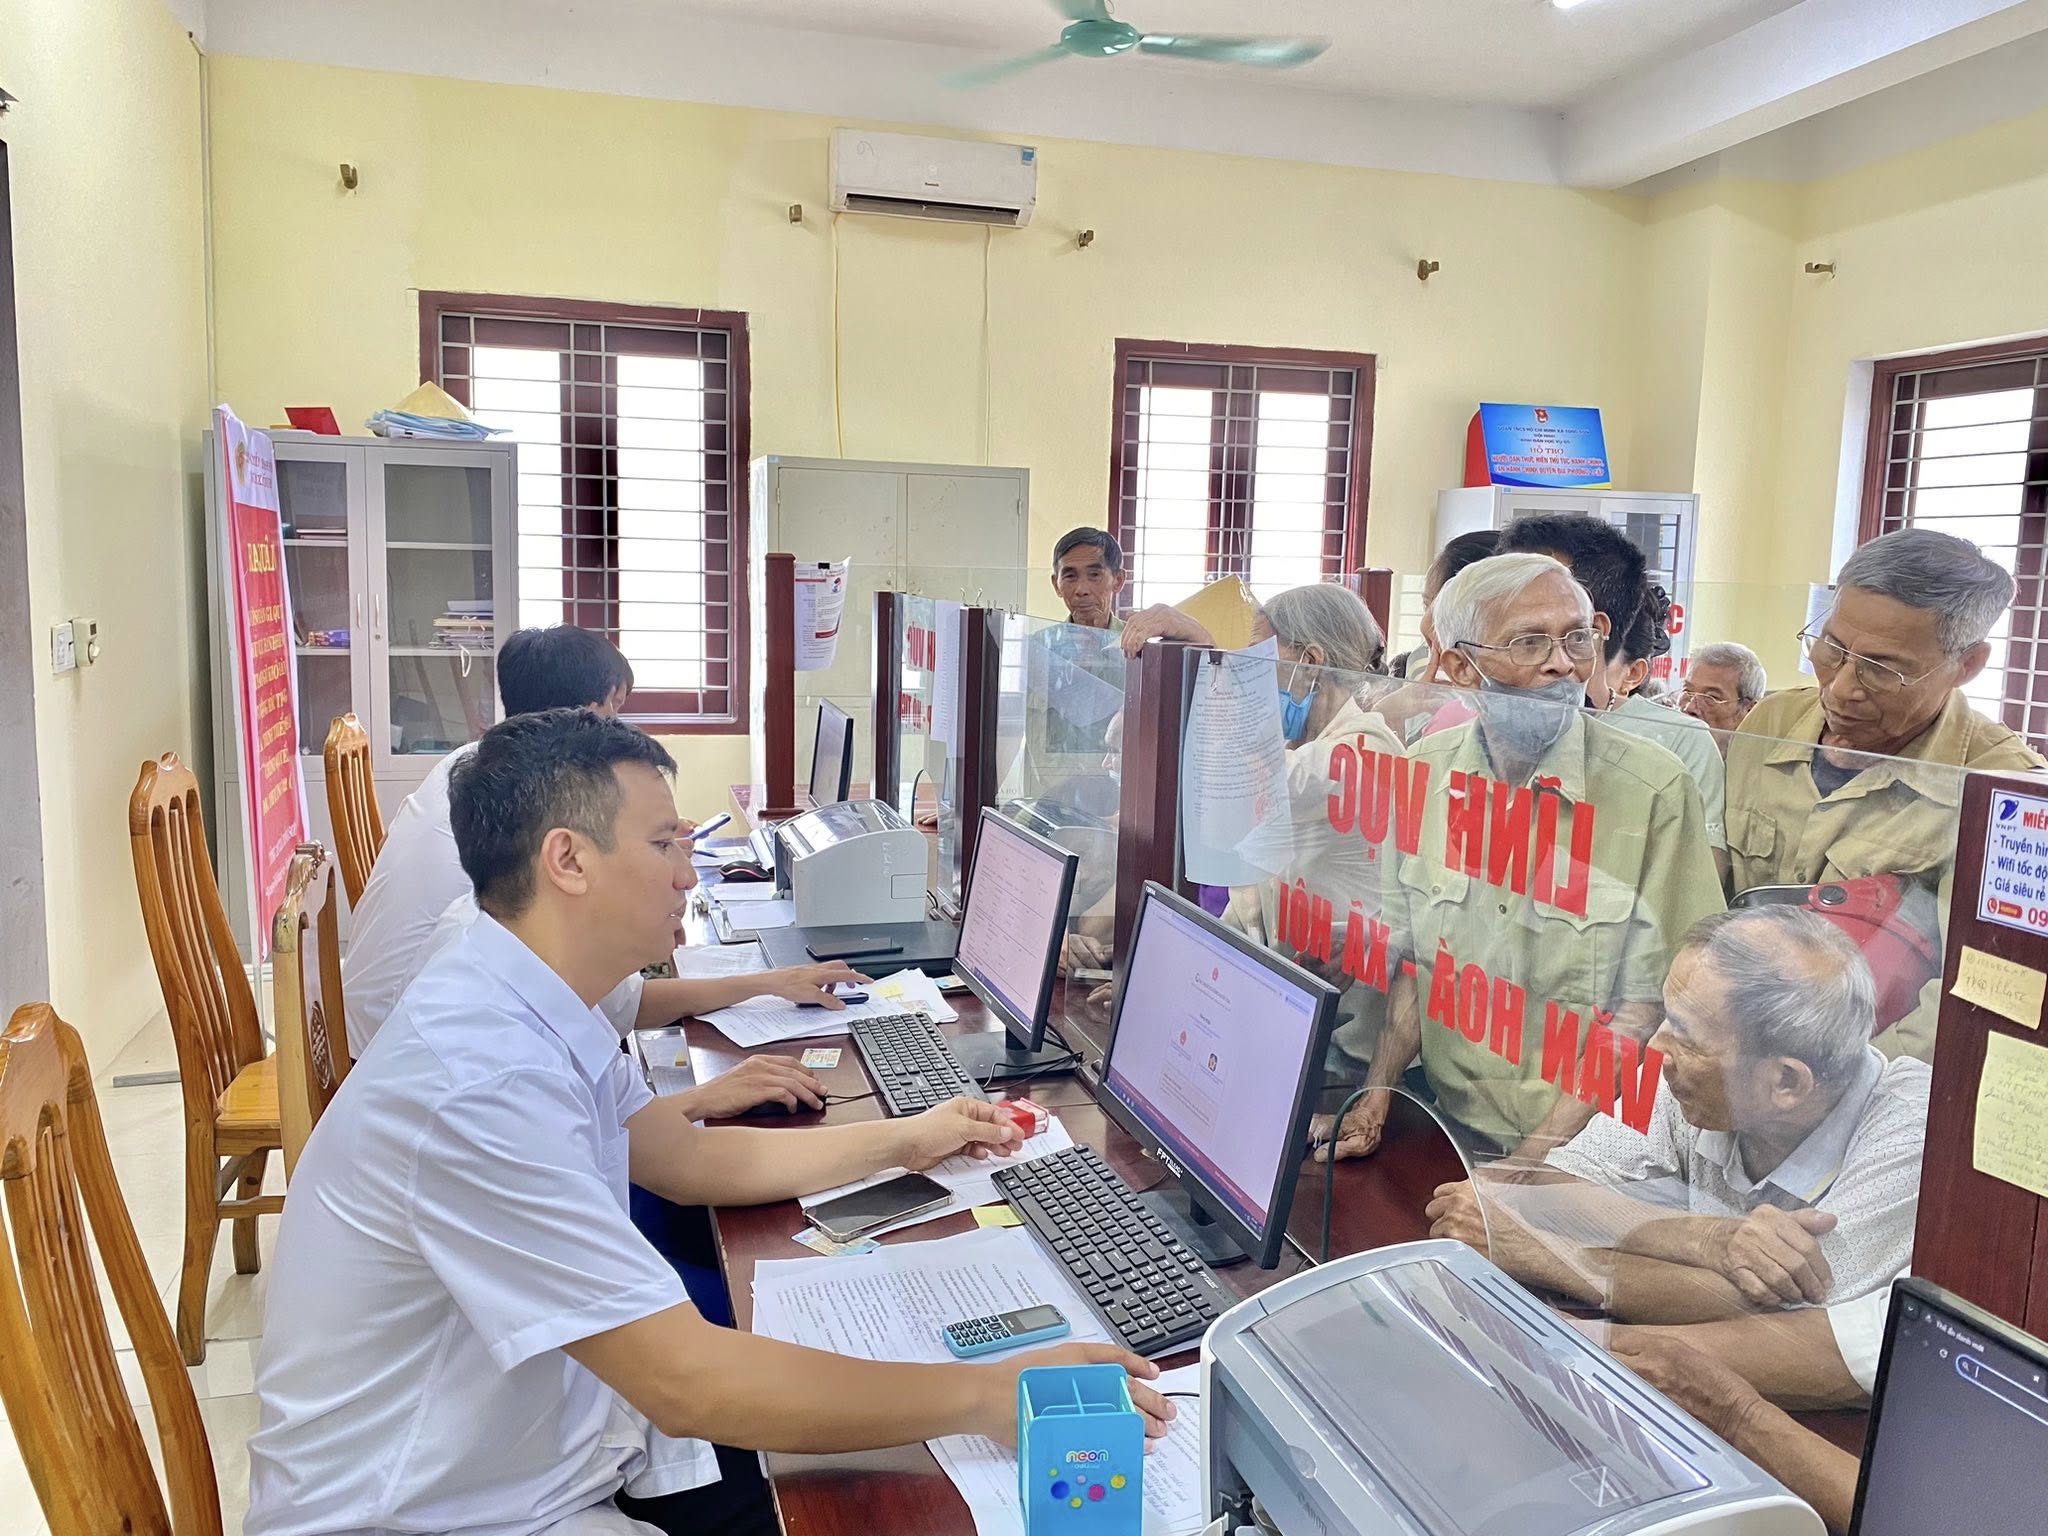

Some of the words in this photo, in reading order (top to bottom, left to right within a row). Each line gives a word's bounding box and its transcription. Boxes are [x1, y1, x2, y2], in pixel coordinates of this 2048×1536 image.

[1995, 823, 2017, 833] VNPT
[2000, 835, 2032, 855] Truyền
[1997, 855, 2015, 872] Wifi
[2017, 859, 2033, 876] tốc
[1994, 877, 2010, 893] Giá
[2012, 882, 2033, 899] siêu
[2036, 885, 2046, 901] rẻ
[1065, 1449, 1109, 1463] neon
